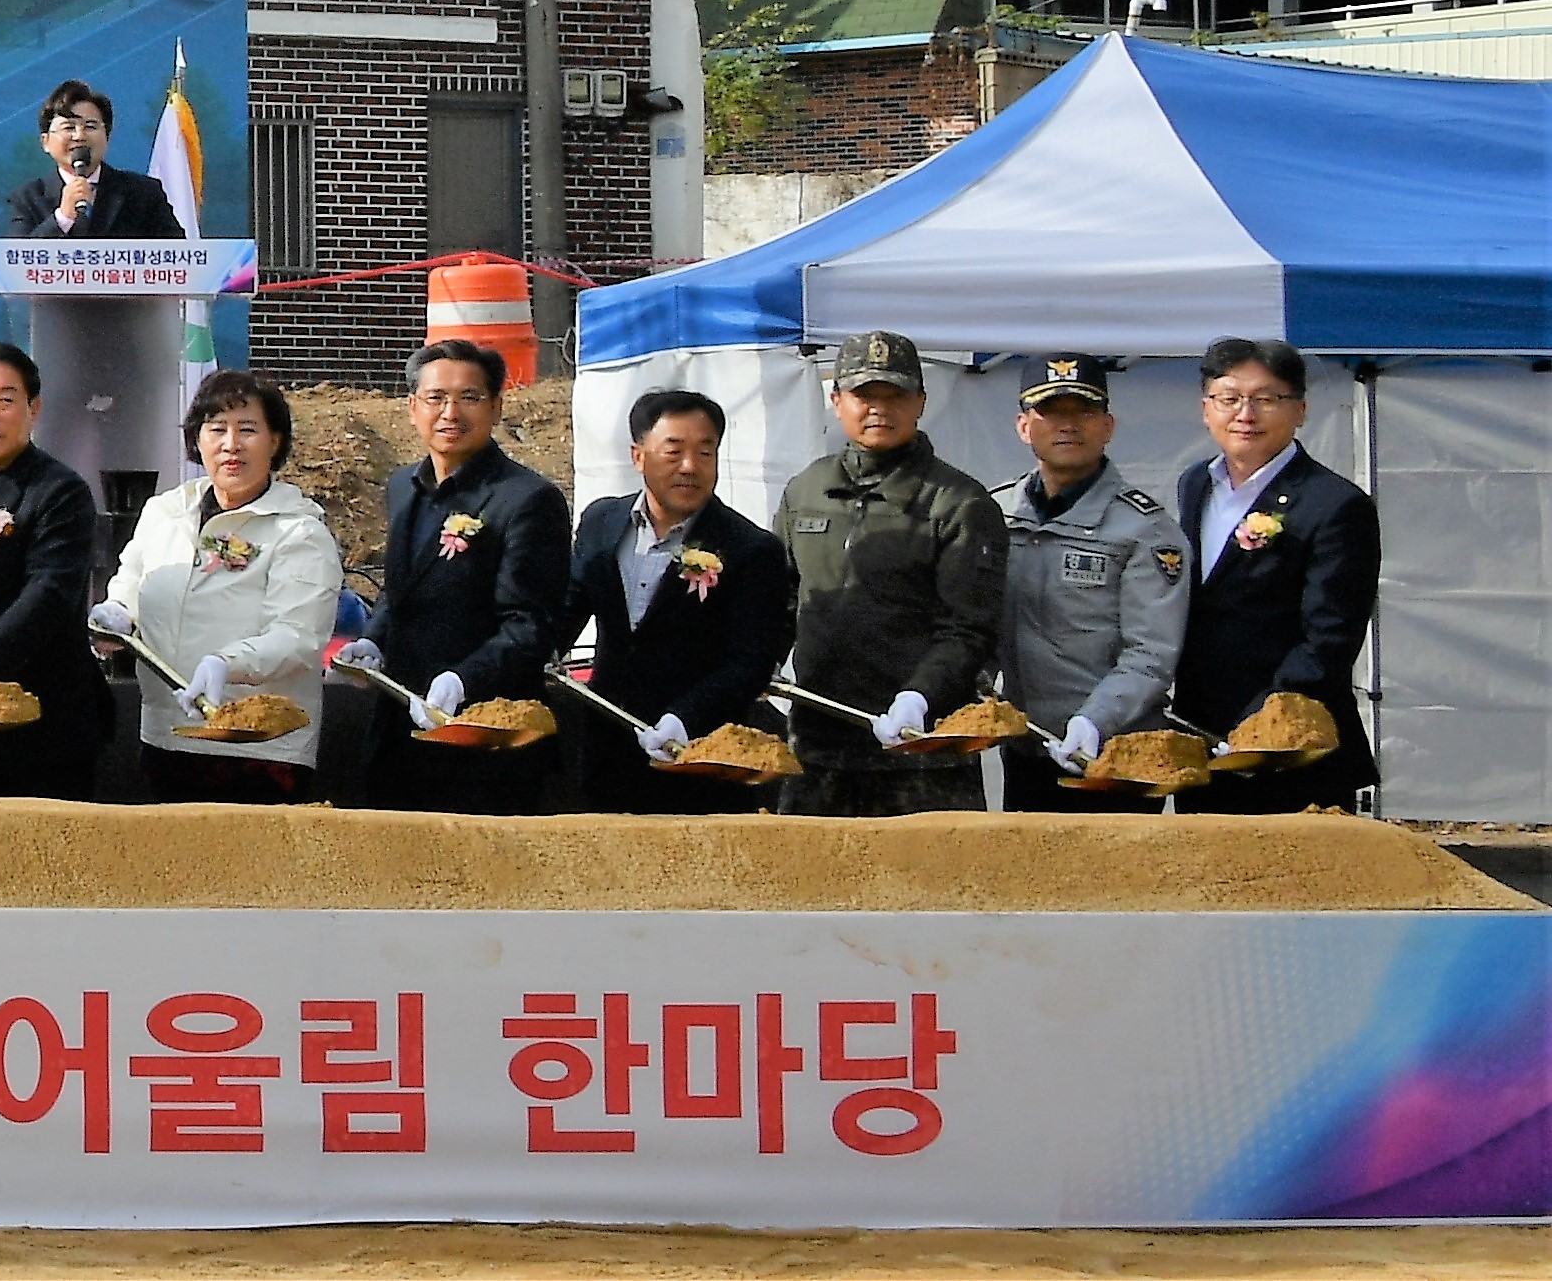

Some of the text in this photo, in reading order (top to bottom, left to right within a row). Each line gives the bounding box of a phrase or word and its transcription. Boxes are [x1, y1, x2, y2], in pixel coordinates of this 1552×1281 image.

[6, 249, 208, 266] 함평읍 농촌중심지활성화사업
[26, 268, 187, 285] 착공기념 어울림 한마당
[501, 992, 957, 1155] 한마당
